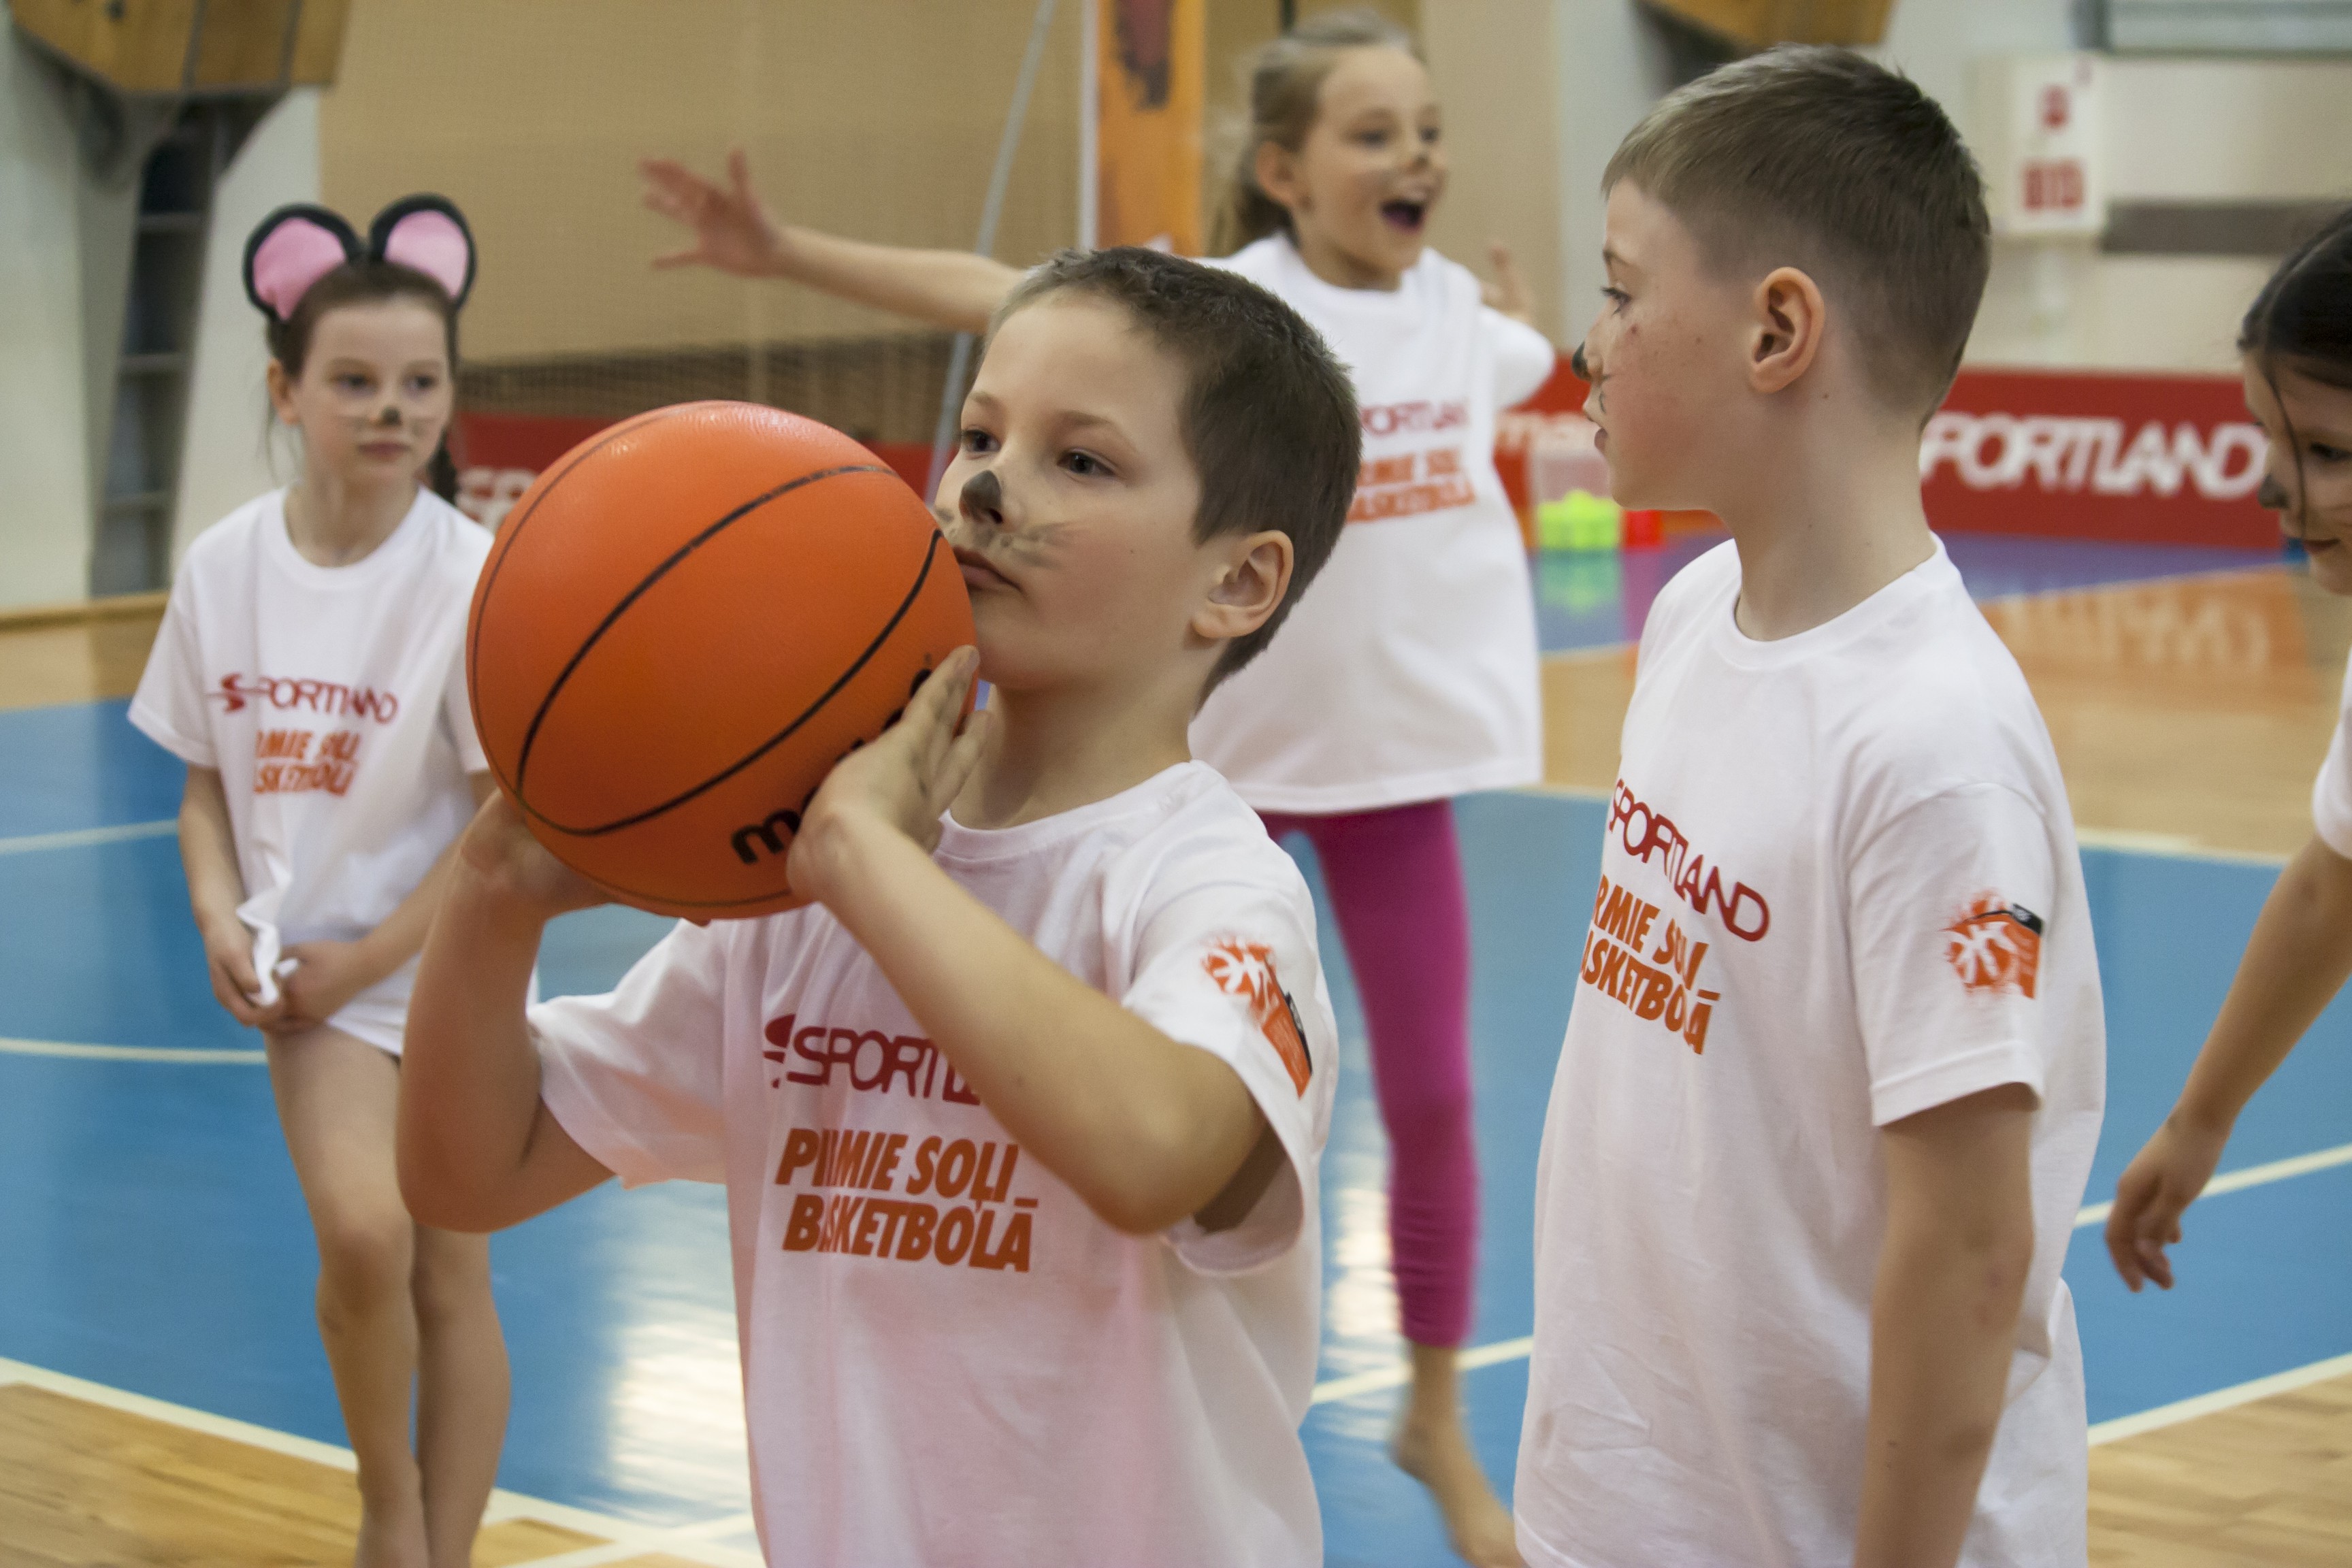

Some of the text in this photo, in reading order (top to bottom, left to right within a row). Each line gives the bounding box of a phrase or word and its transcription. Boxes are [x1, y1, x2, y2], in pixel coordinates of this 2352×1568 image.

[1921, 410, 2269, 501] PORTLAND
[1592, 874, 1661, 954] RMIE
[786, 1026, 981, 1106] SPORTL
